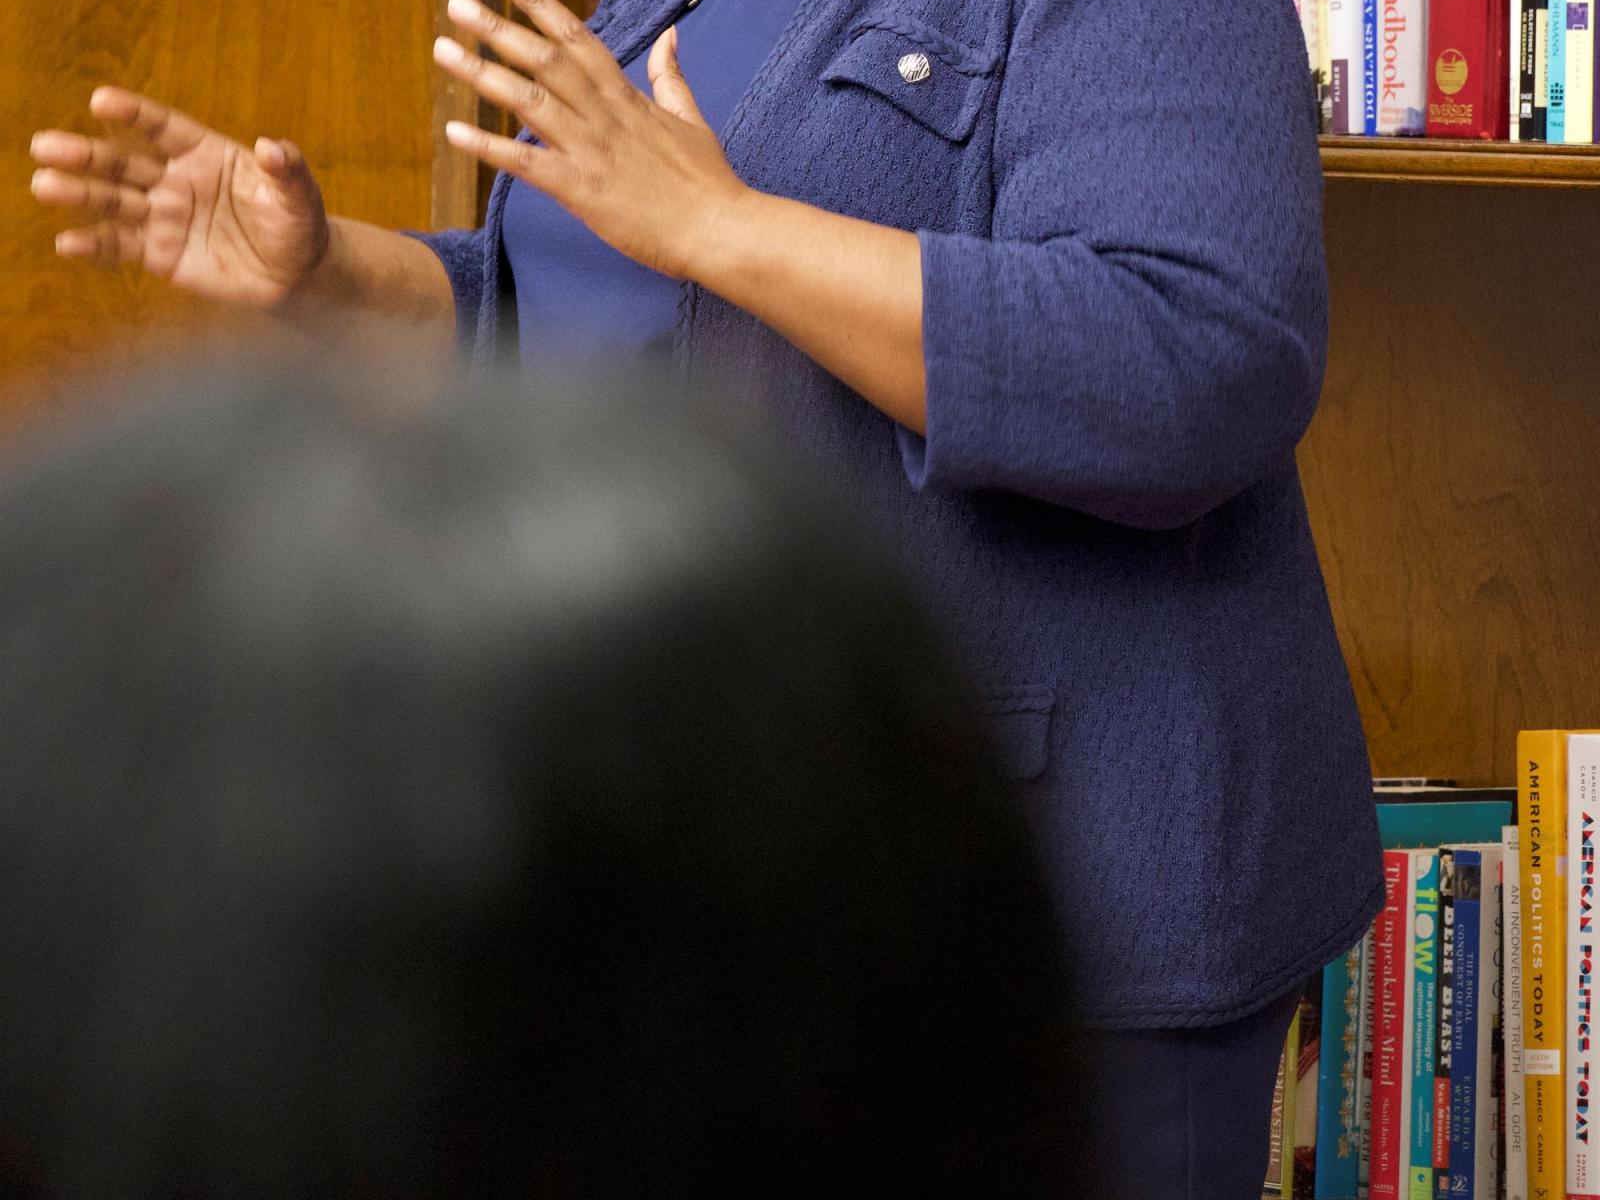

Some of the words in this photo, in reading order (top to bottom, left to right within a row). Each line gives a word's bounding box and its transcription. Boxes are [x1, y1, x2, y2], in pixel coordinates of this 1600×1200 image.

[1333, 66, 1341, 103] PLINER
[1362, 25, 1375, 120] DOLLARS
[1528, 760, 1542, 868] AMERICAN
[1385, 862, 1401, 900] The
[1511, 884, 1521, 904] AN
[1579, 811, 1595, 934] AMERICAN
[1414, 887, 1439, 975] flow
[1531, 873, 1543, 969] POLITICS
[1378, 905, 1399, 1030] Unspeakable
[1455, 923, 1465, 987] CONQUEST
[1465, 951, 1474, 977] THE
[1511, 911, 1521, 1021] INCONVENIENT
[1415, 981, 1425, 1018] optimal
[1427, 982, 1435, 999] the
[1455, 990, 1464, 1007] OF
[1464, 979, 1474, 1024] SOCIAL
[1532, 973, 1544, 1043] TODAY
[1577, 944, 1593, 1054] POLITICS
[1415, 1021, 1423, 1076] experience
[1423, 1001, 1434, 1059] psychology
[1454, 1010, 1464, 1050] EARTH
[1511, 1025, 1521, 1074] TRUTH
[1380, 1036, 1395, 1086] Mind
[1424, 1061, 1433, 1072] of
[1363, 1095, 1372, 1121] TOM
[1452, 1085, 1461, 1142] WILSON
[1462, 1075, 1471, 1134] EDWARD
[1511, 1092, 1521, 1108] AL
[1536, 1080, 1544, 1123] BIANCO
[1575, 1061, 1590, 1146] TODAY
[1362, 1129, 1372, 1162] RATH
[1462, 1141, 1470, 1153] O.
[1511, 1114, 1521, 1152] GORE
